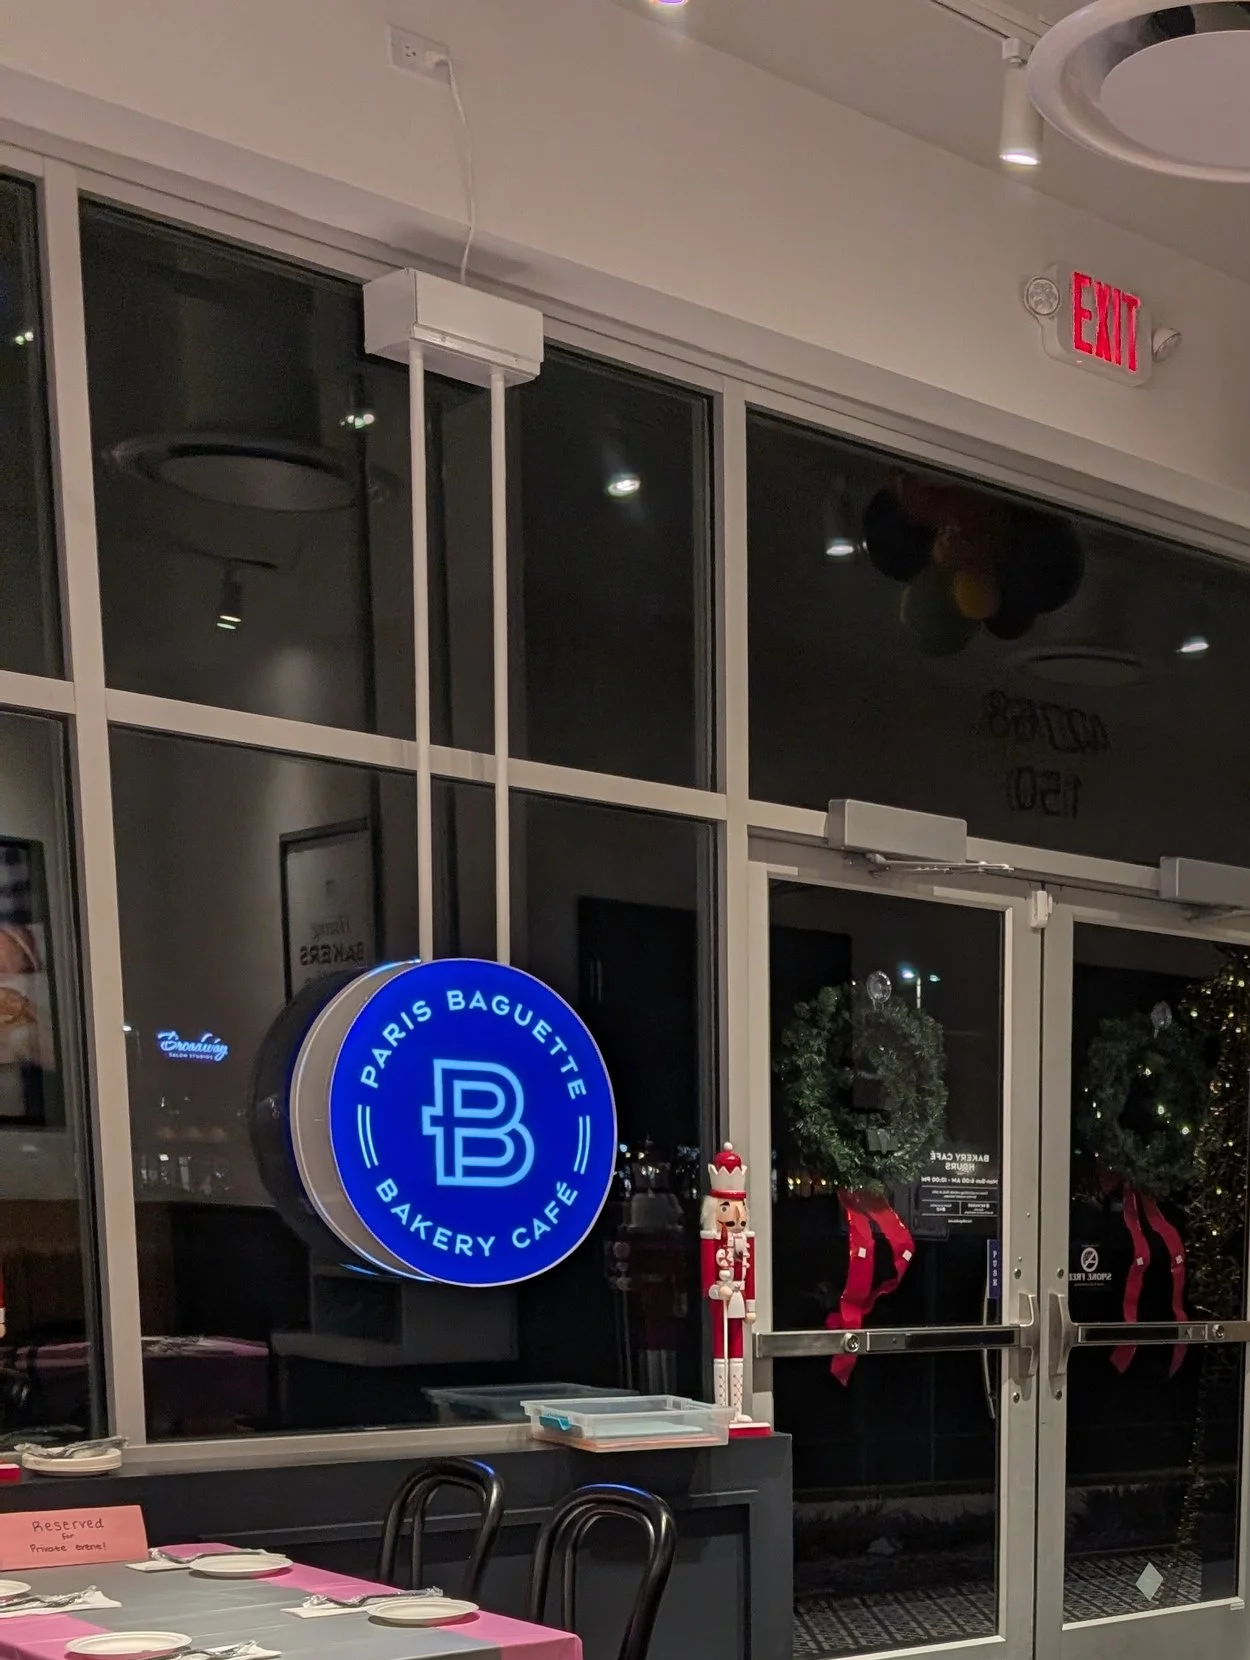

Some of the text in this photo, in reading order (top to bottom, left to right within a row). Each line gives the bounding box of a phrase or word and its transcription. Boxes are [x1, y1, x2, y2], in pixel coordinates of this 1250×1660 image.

[1072, 272, 1141, 373] EXIT
[360, 988, 587, 1098] PARIS BAGUETTE
[375, 1179, 578, 1259] BAKERY CAFÉ
[30, 1544, 67, 1553] Private
[31, 1518, 105, 1532] Reserved
